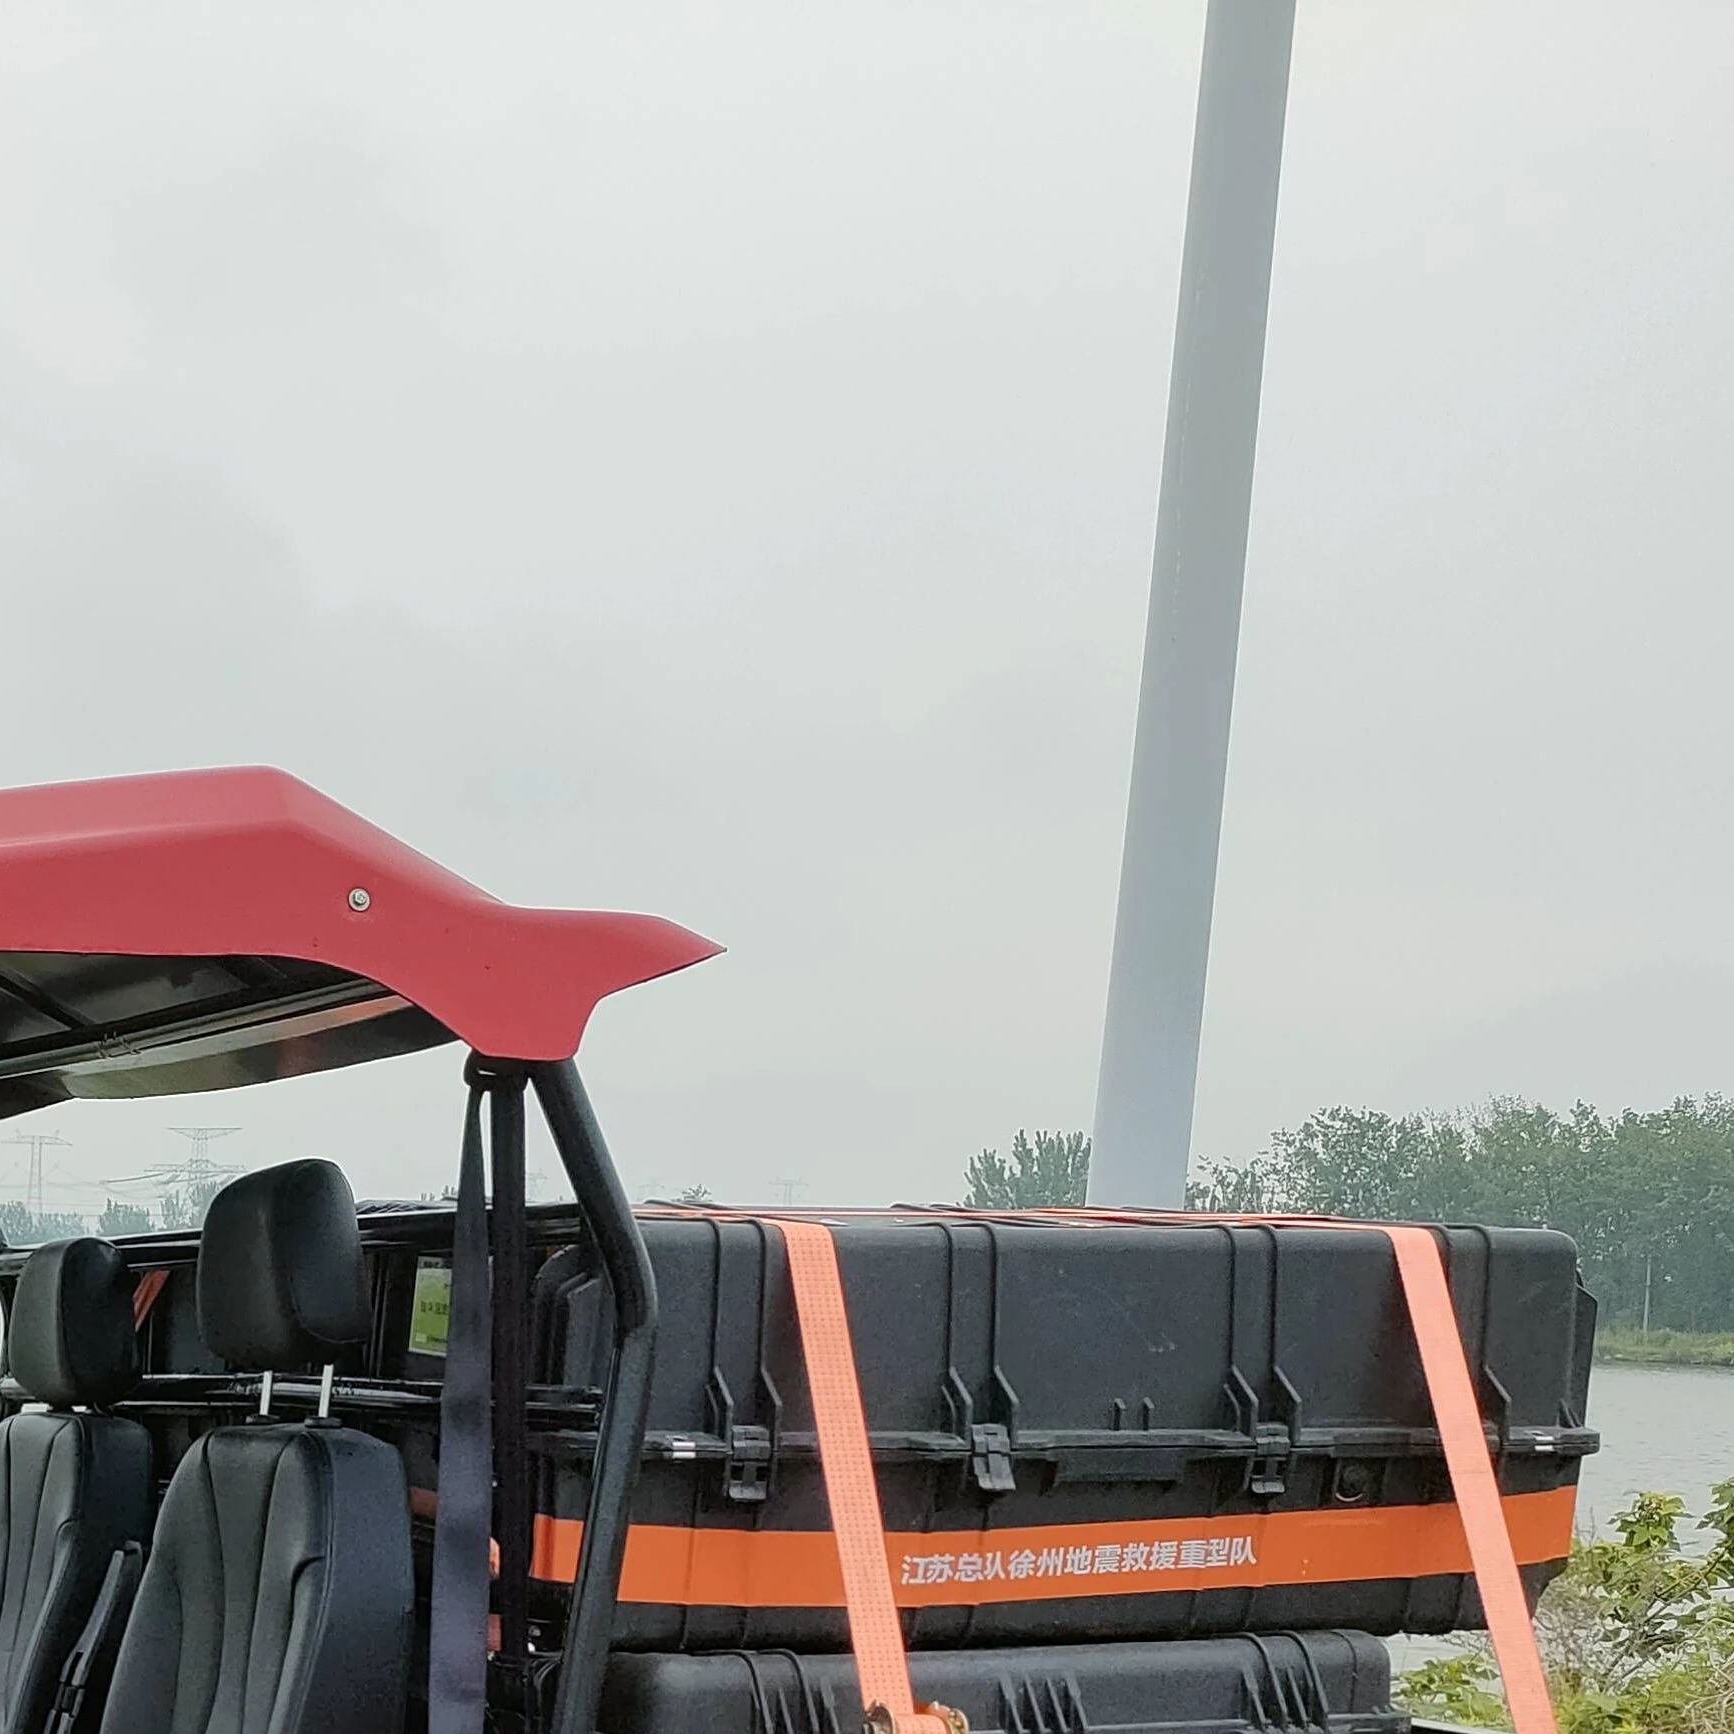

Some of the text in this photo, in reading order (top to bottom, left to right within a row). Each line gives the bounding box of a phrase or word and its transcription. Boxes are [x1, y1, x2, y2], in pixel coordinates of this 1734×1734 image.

[901, 1536, 1257, 1585] 江苏总队徐州地震救援重型队
